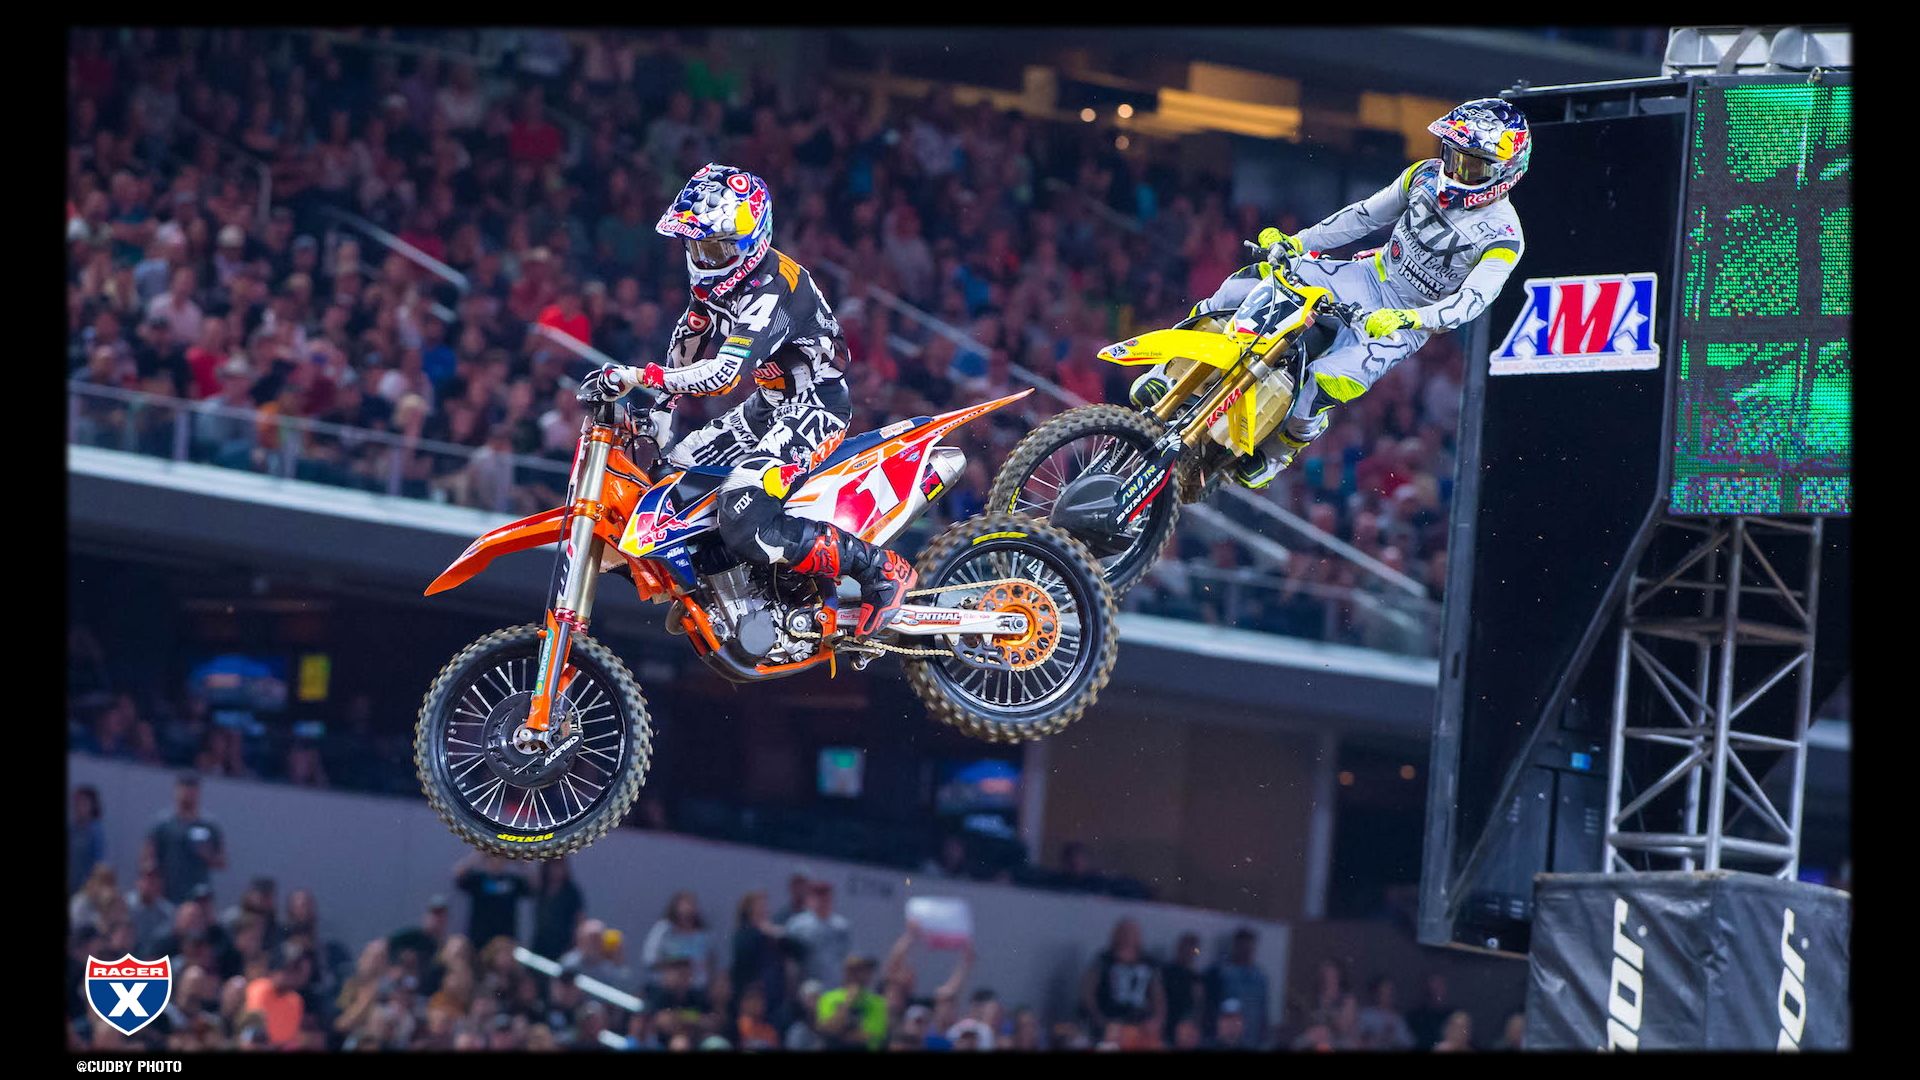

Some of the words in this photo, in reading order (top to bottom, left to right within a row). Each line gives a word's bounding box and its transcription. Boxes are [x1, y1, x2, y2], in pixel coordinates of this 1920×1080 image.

[1449, 129, 1469, 146] Bull
[1464, 184, 1496, 207] Red
[657, 221, 679, 232] Red
[676, 222, 702, 239] Bull
[712, 267, 747, 298] Red
[743, 238, 770, 276] Bull
[1398, 264, 1441, 301] JOHN'S
[1403, 255, 1446, 292] JIMMY
[1421, 253, 1464, 281] Eagle
[1501, 280, 1655, 357] AMA
[688, 359, 738, 394] SIXTEEN
[1206, 387, 1243, 429] KYB
[734, 491, 753, 515] FOX
[855, 462, 900, 516] 1
[1115, 468, 1166, 525] DUNLOP
[537, 636, 553, 681] MOTOREX
[544, 735, 580, 767] ACERBIS
[497, 831, 555, 843] DUNLOP
